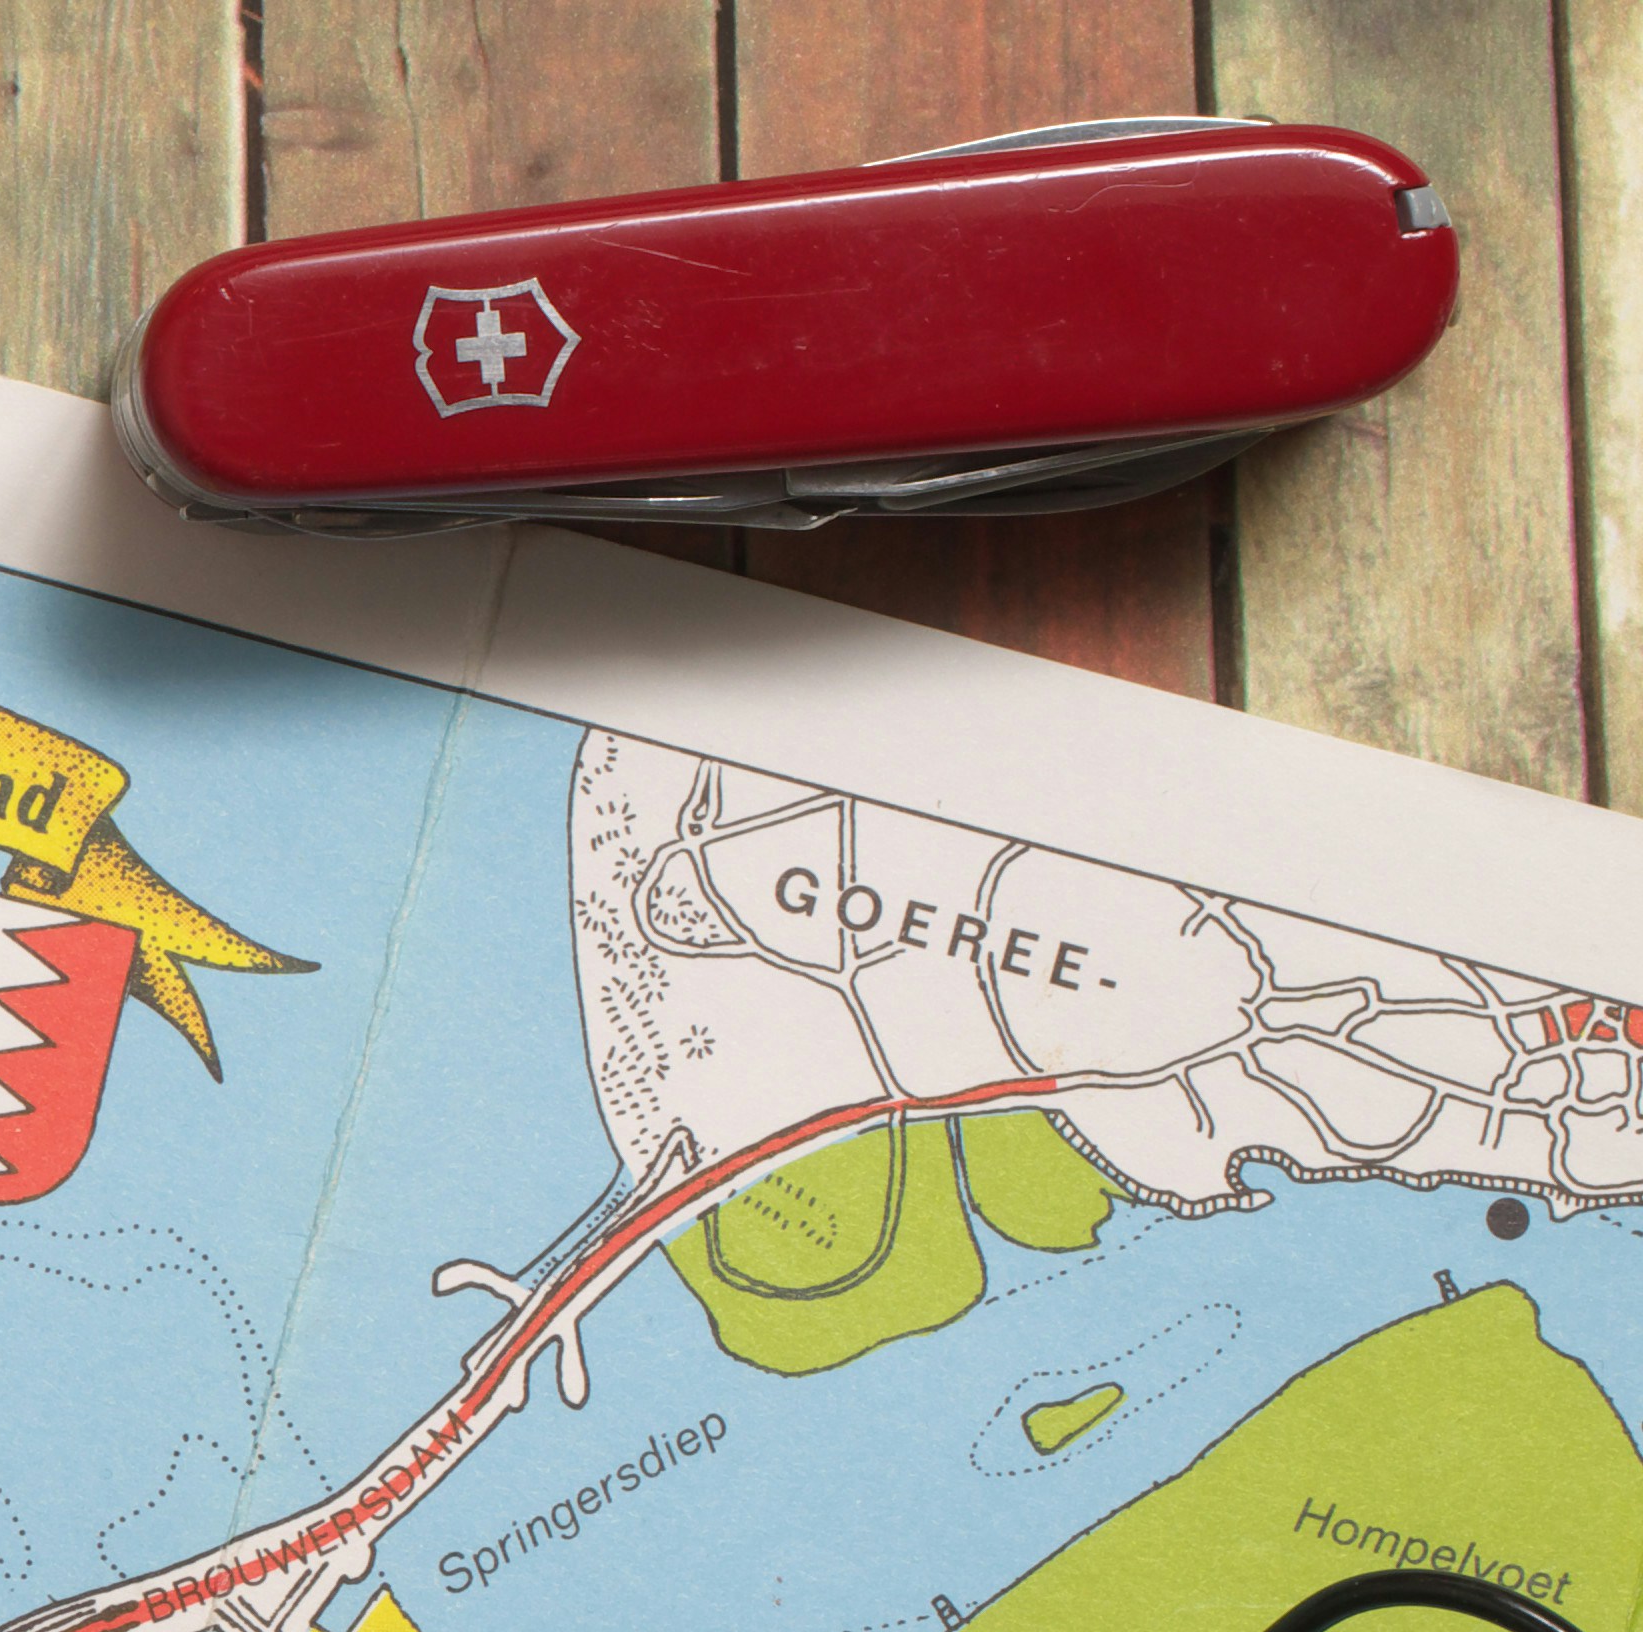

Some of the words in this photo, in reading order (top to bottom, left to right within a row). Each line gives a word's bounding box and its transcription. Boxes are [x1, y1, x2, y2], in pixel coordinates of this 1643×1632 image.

[773, 864, 1119, 992] GOEREE-
[141, 1409, 475, 1626] BROUWERSDAM
[438, 1410, 730, 1599] Springersdiep
[1292, 1495, 1574, 1607] Hompelvoet
